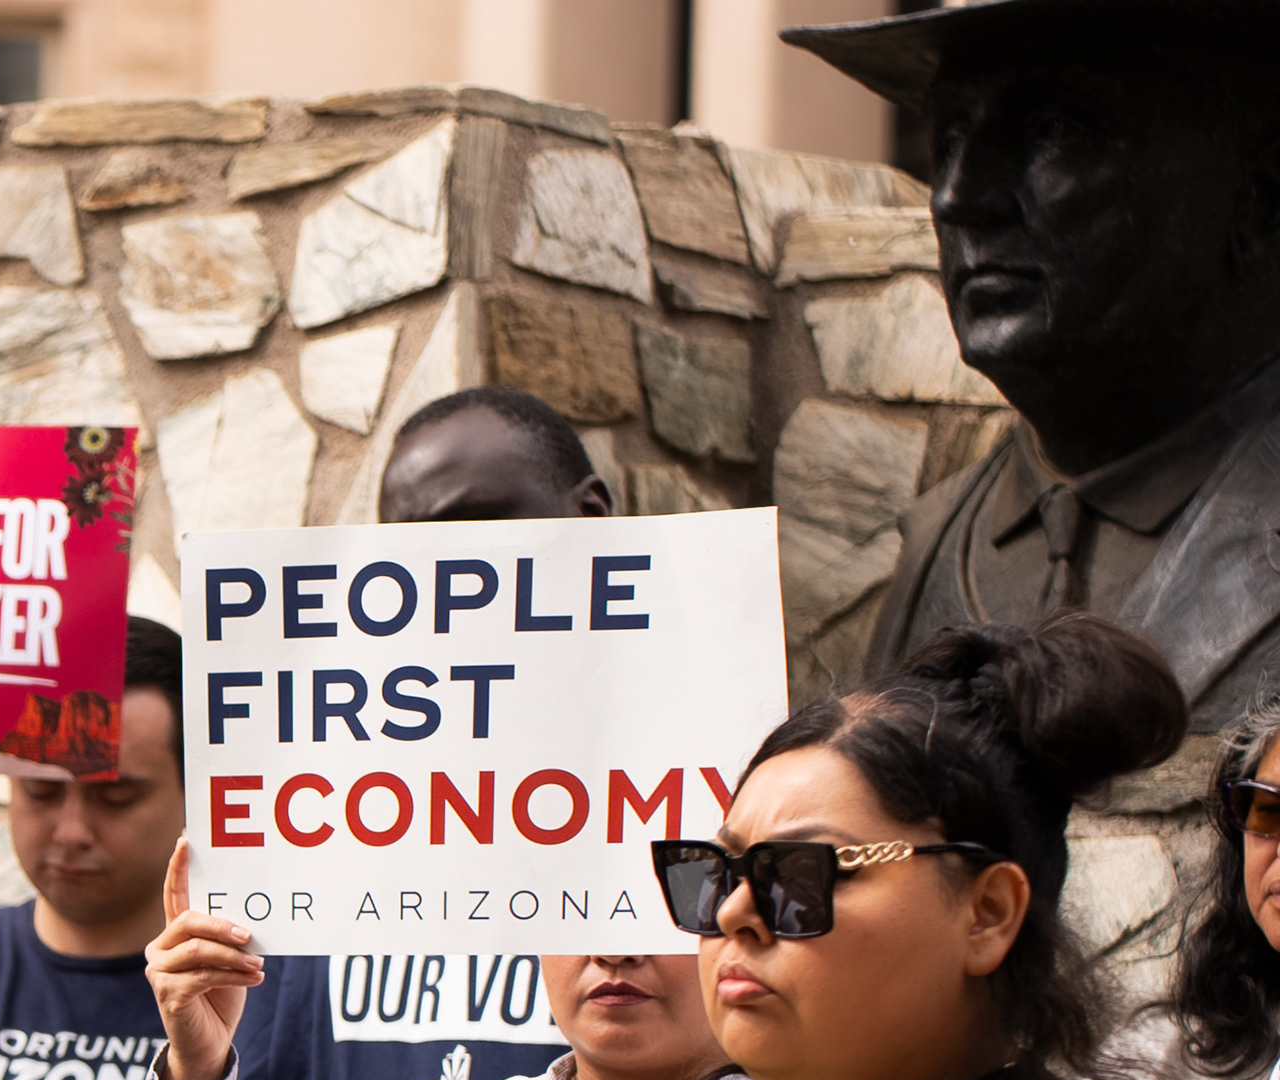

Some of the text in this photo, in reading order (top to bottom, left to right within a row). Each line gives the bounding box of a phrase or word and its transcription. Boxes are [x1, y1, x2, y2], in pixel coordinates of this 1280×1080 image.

[205, 555, 652, 641] PEOPLE
[207, 664, 515, 745] FIRST
[207, 889, 637, 921] FOR ARIZONA
[341, 955, 558, 1026] OUR VO
